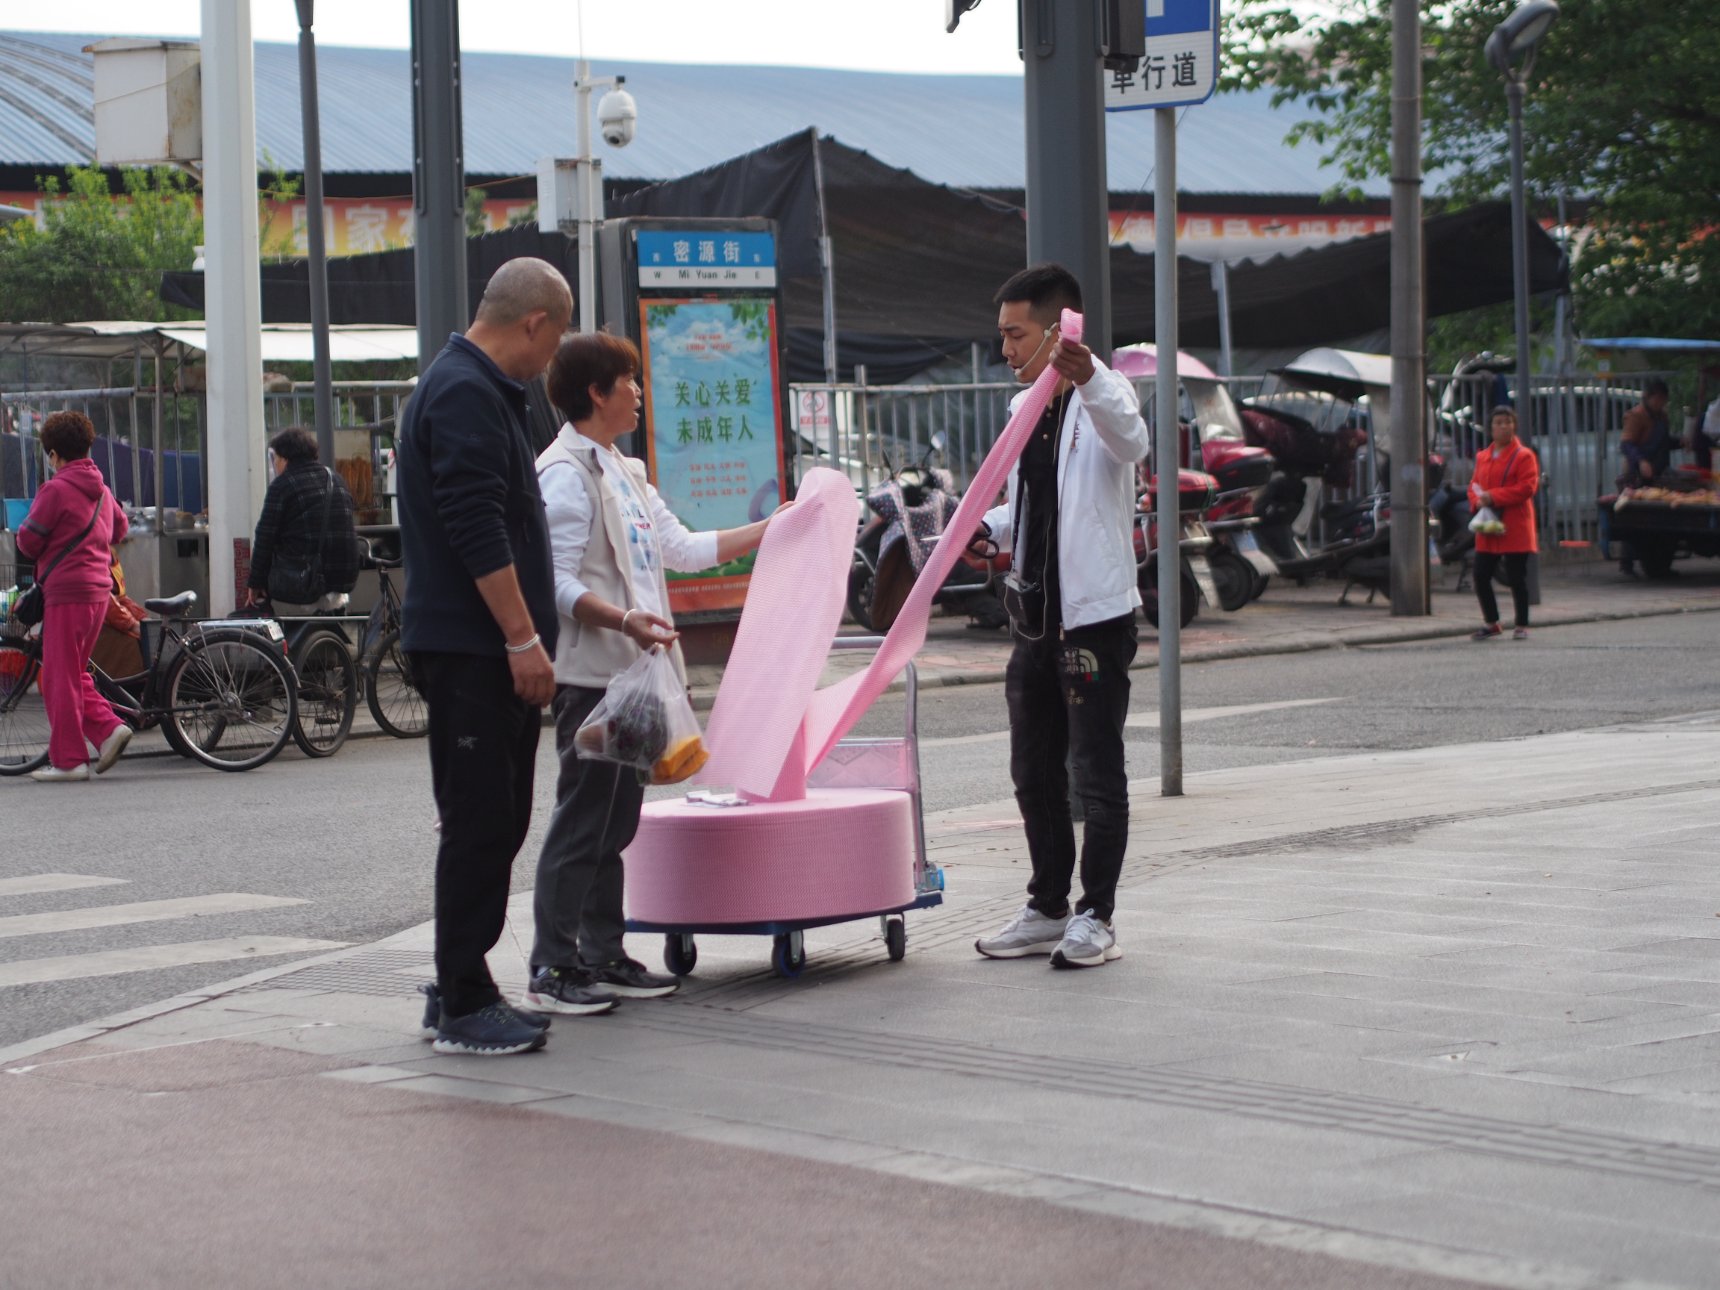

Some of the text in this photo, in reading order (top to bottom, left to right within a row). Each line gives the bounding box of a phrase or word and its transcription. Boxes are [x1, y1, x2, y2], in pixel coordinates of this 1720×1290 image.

[673, 240, 740, 263] 密源街
[678, 270, 690, 279] Mi
[696, 270, 718, 279] Yuan
[724, 270, 737, 279] Jie
[675, 379, 751, 407] 关心关爱
[677, 414, 753, 443] 未成年人
